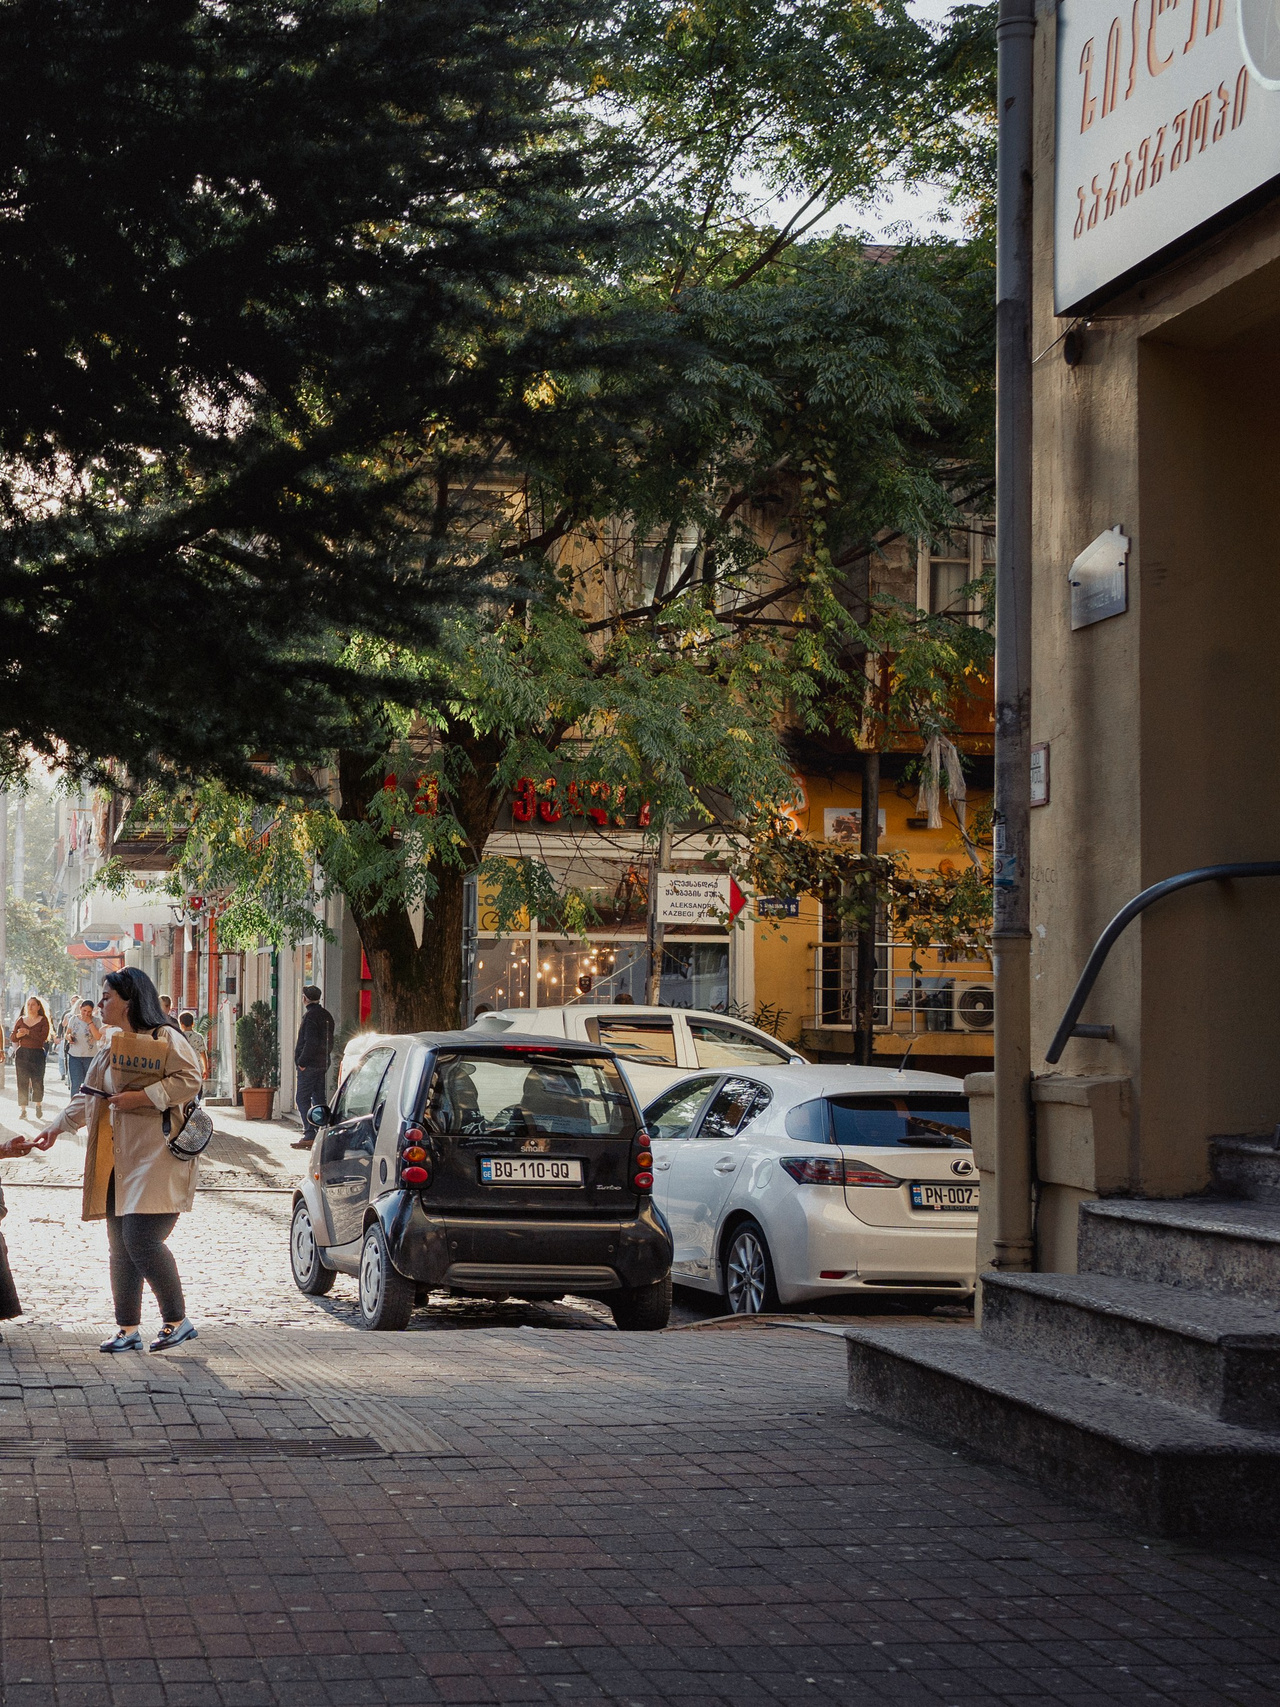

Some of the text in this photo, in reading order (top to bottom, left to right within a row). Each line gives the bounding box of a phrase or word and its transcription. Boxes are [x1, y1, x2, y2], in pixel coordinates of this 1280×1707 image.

[1073, 64, 1250, 241] ბარბერშოპი
[662, 910, 694, 918] KAZBEGI
[112, 1053, 161, 1070] ბიბლუსი
[521, 1144, 545, 1153] smart
[483, 1170, 492, 1178] GE
[494, 1161, 570, 1179] BQ-110-QQ
[925, 1187, 980, 1204] PN-007-
